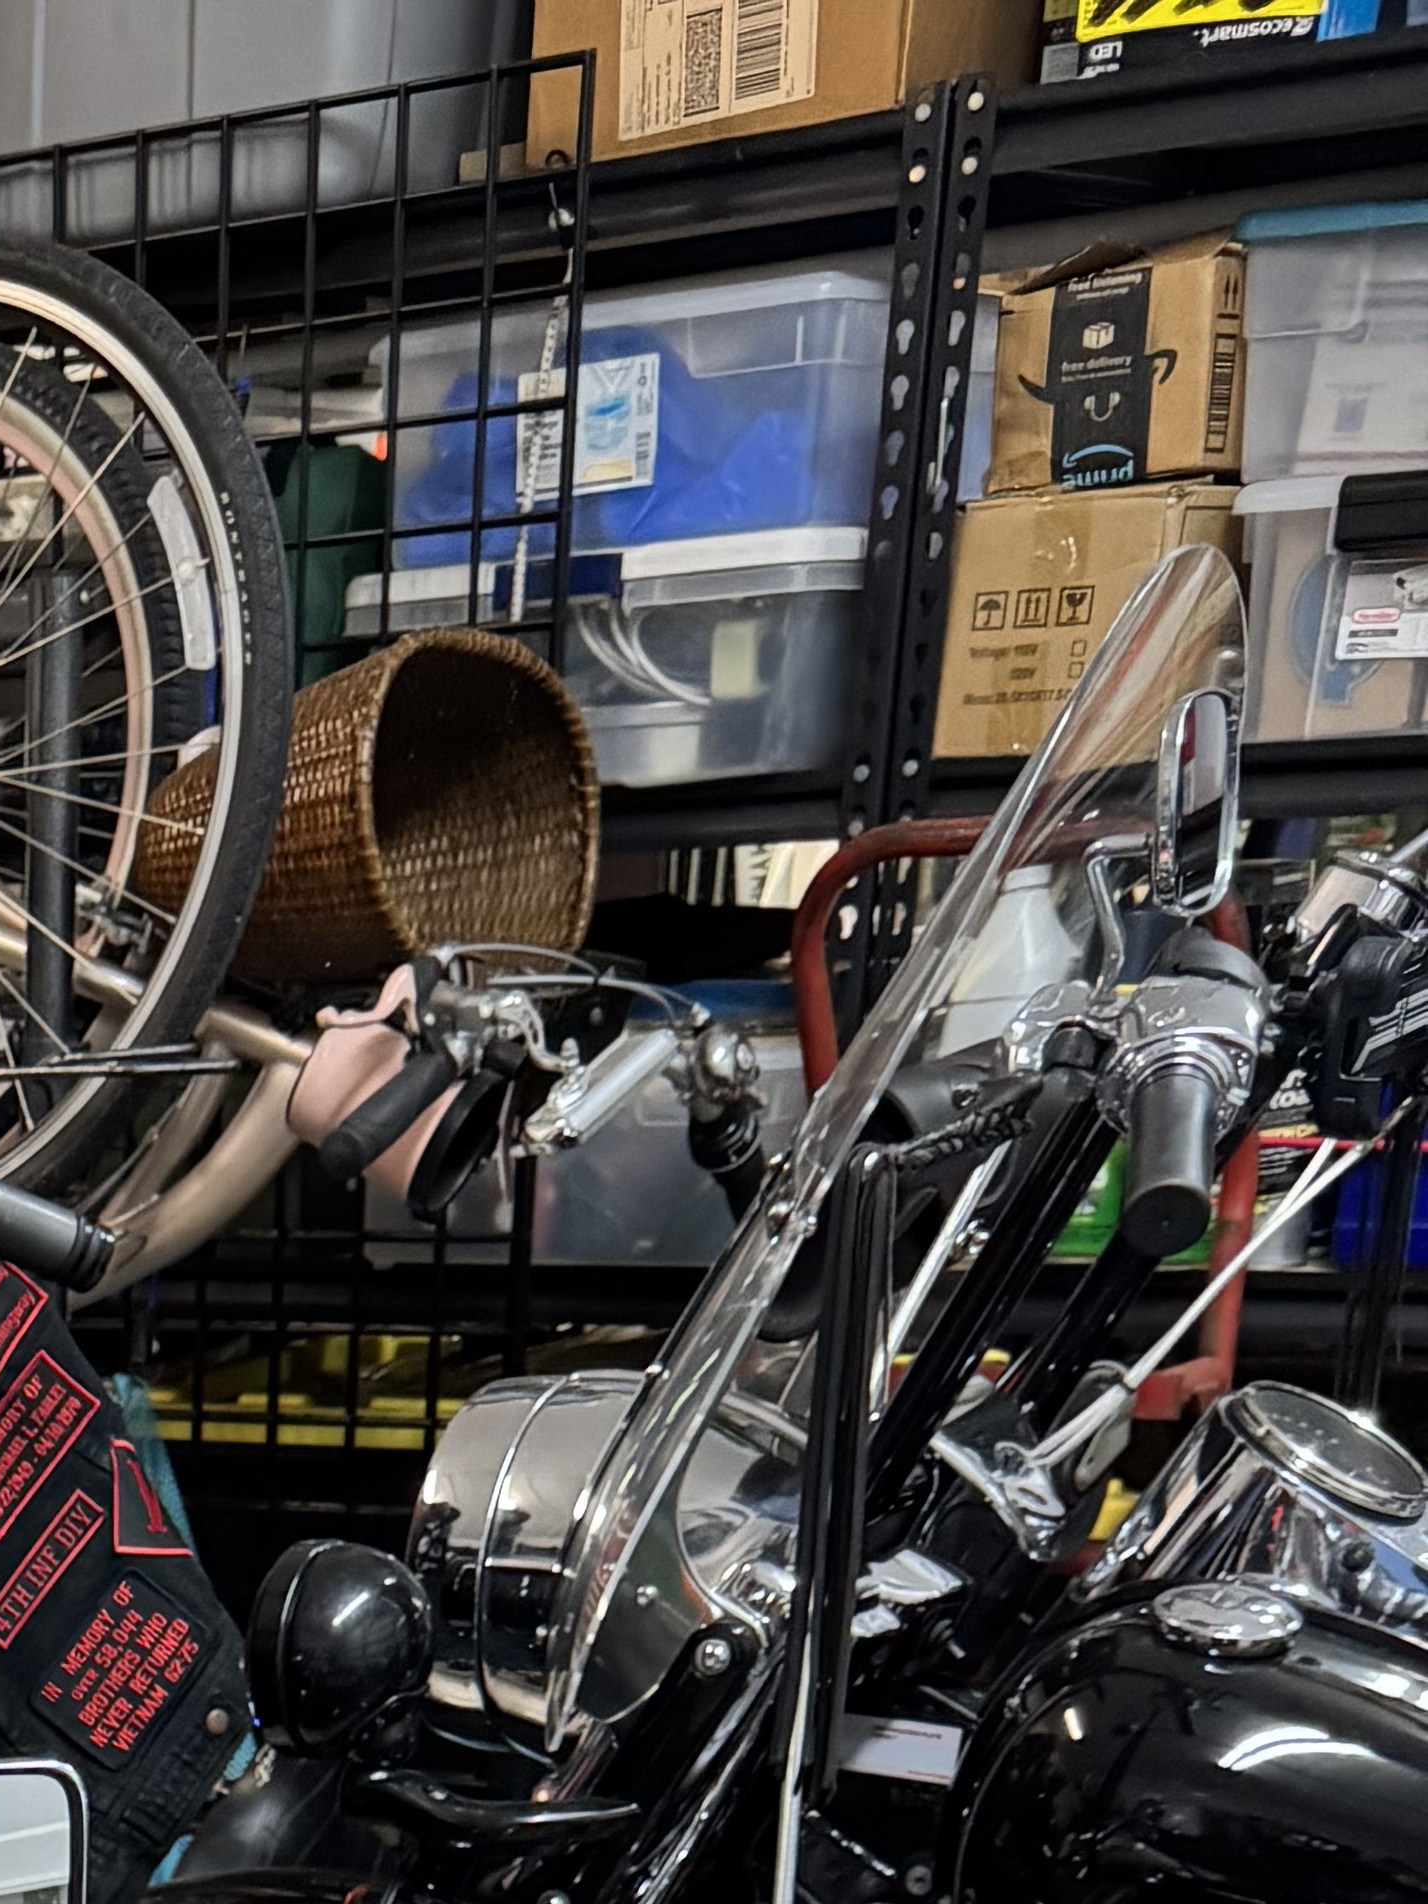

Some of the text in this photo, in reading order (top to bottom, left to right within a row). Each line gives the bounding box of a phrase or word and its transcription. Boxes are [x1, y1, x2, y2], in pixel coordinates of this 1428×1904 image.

[1090, 41, 1123, 60] LED
[24, 1544, 61, 1588] INF
[40, 1579, 135, 1704] IN MEMORY OF
[77, 1611, 168, 1728] BROTHERS WHO
[70, 1667, 100, 1702] OVER
[88, 1617, 191, 1749] NEVER RETURNED
[111, 1682, 170, 1753] VIETNAM
